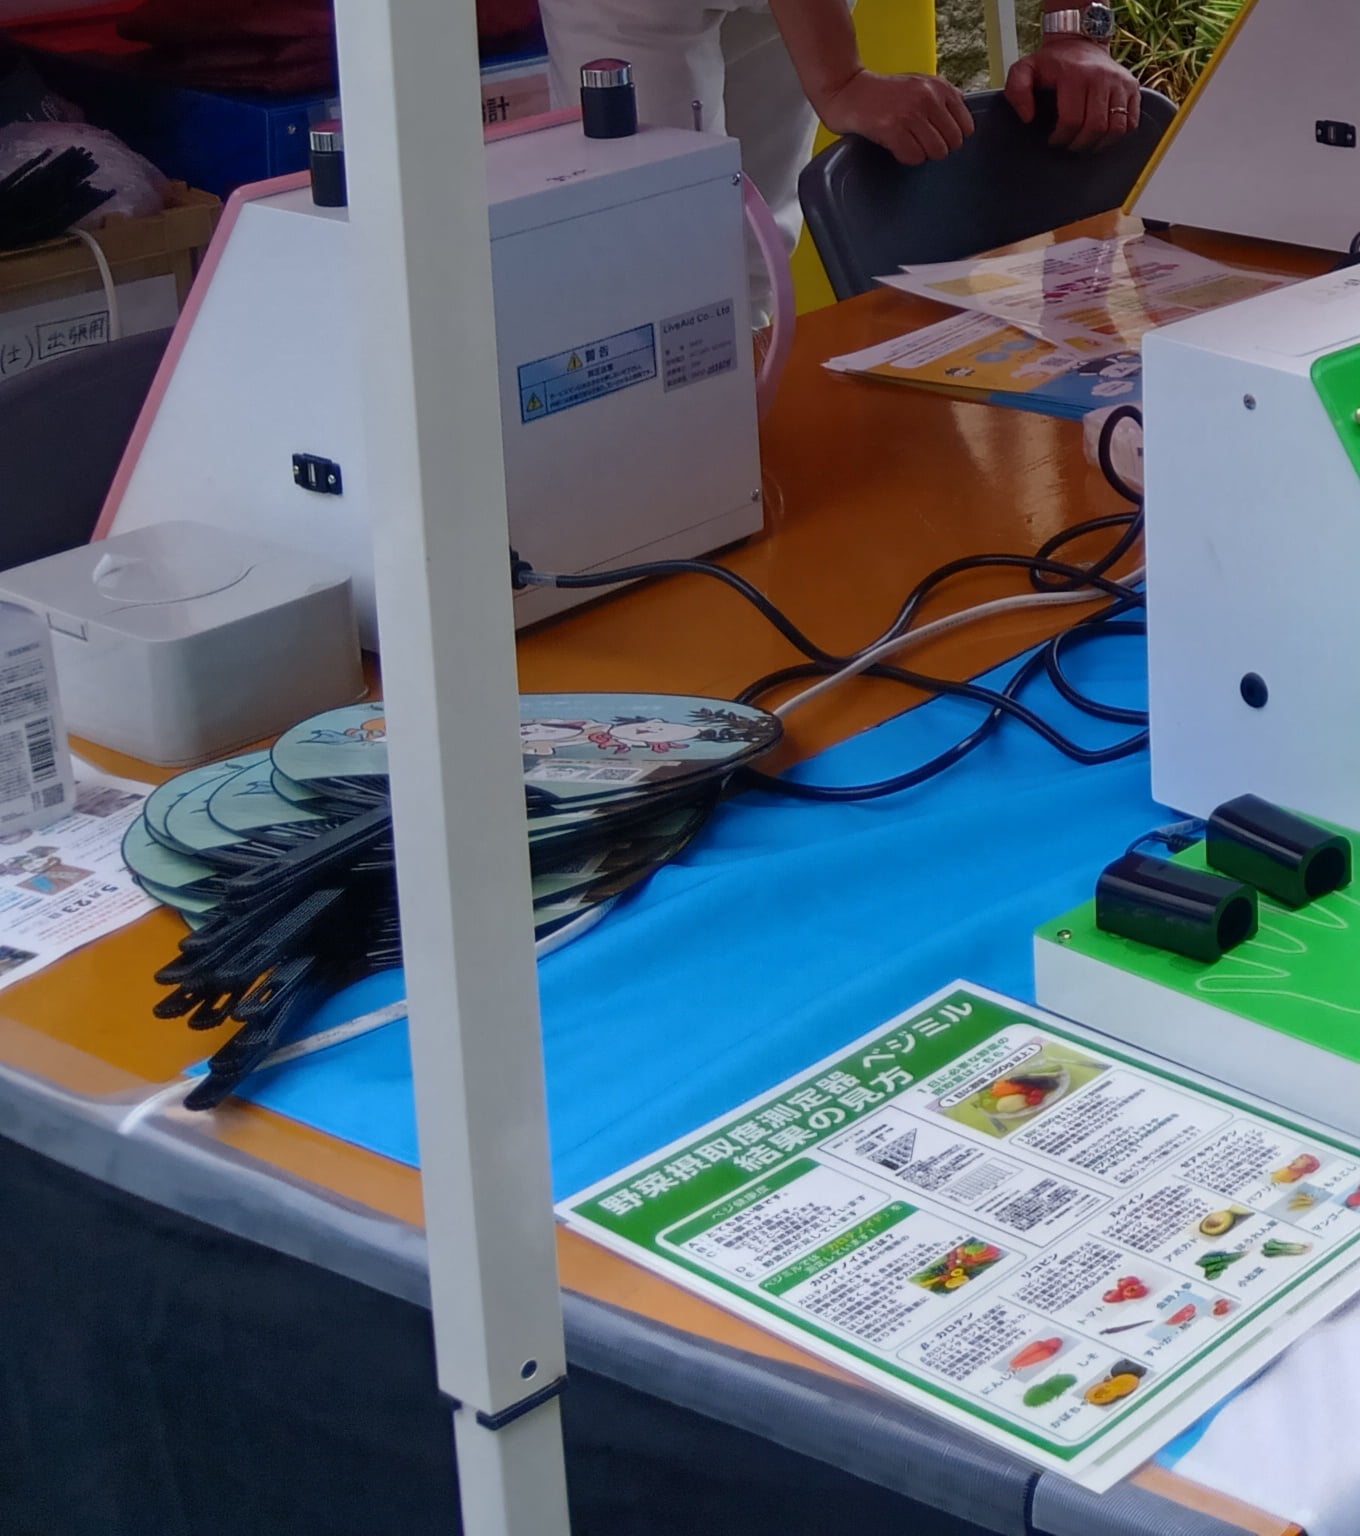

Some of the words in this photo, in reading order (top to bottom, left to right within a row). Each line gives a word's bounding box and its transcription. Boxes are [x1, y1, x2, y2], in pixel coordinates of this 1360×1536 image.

[594, 1068, 865, 1217] 野菜摂取度測定器
[860, 999, 974, 1072] ベジミル
[728, 1064, 921, 1174] 結果の見方
